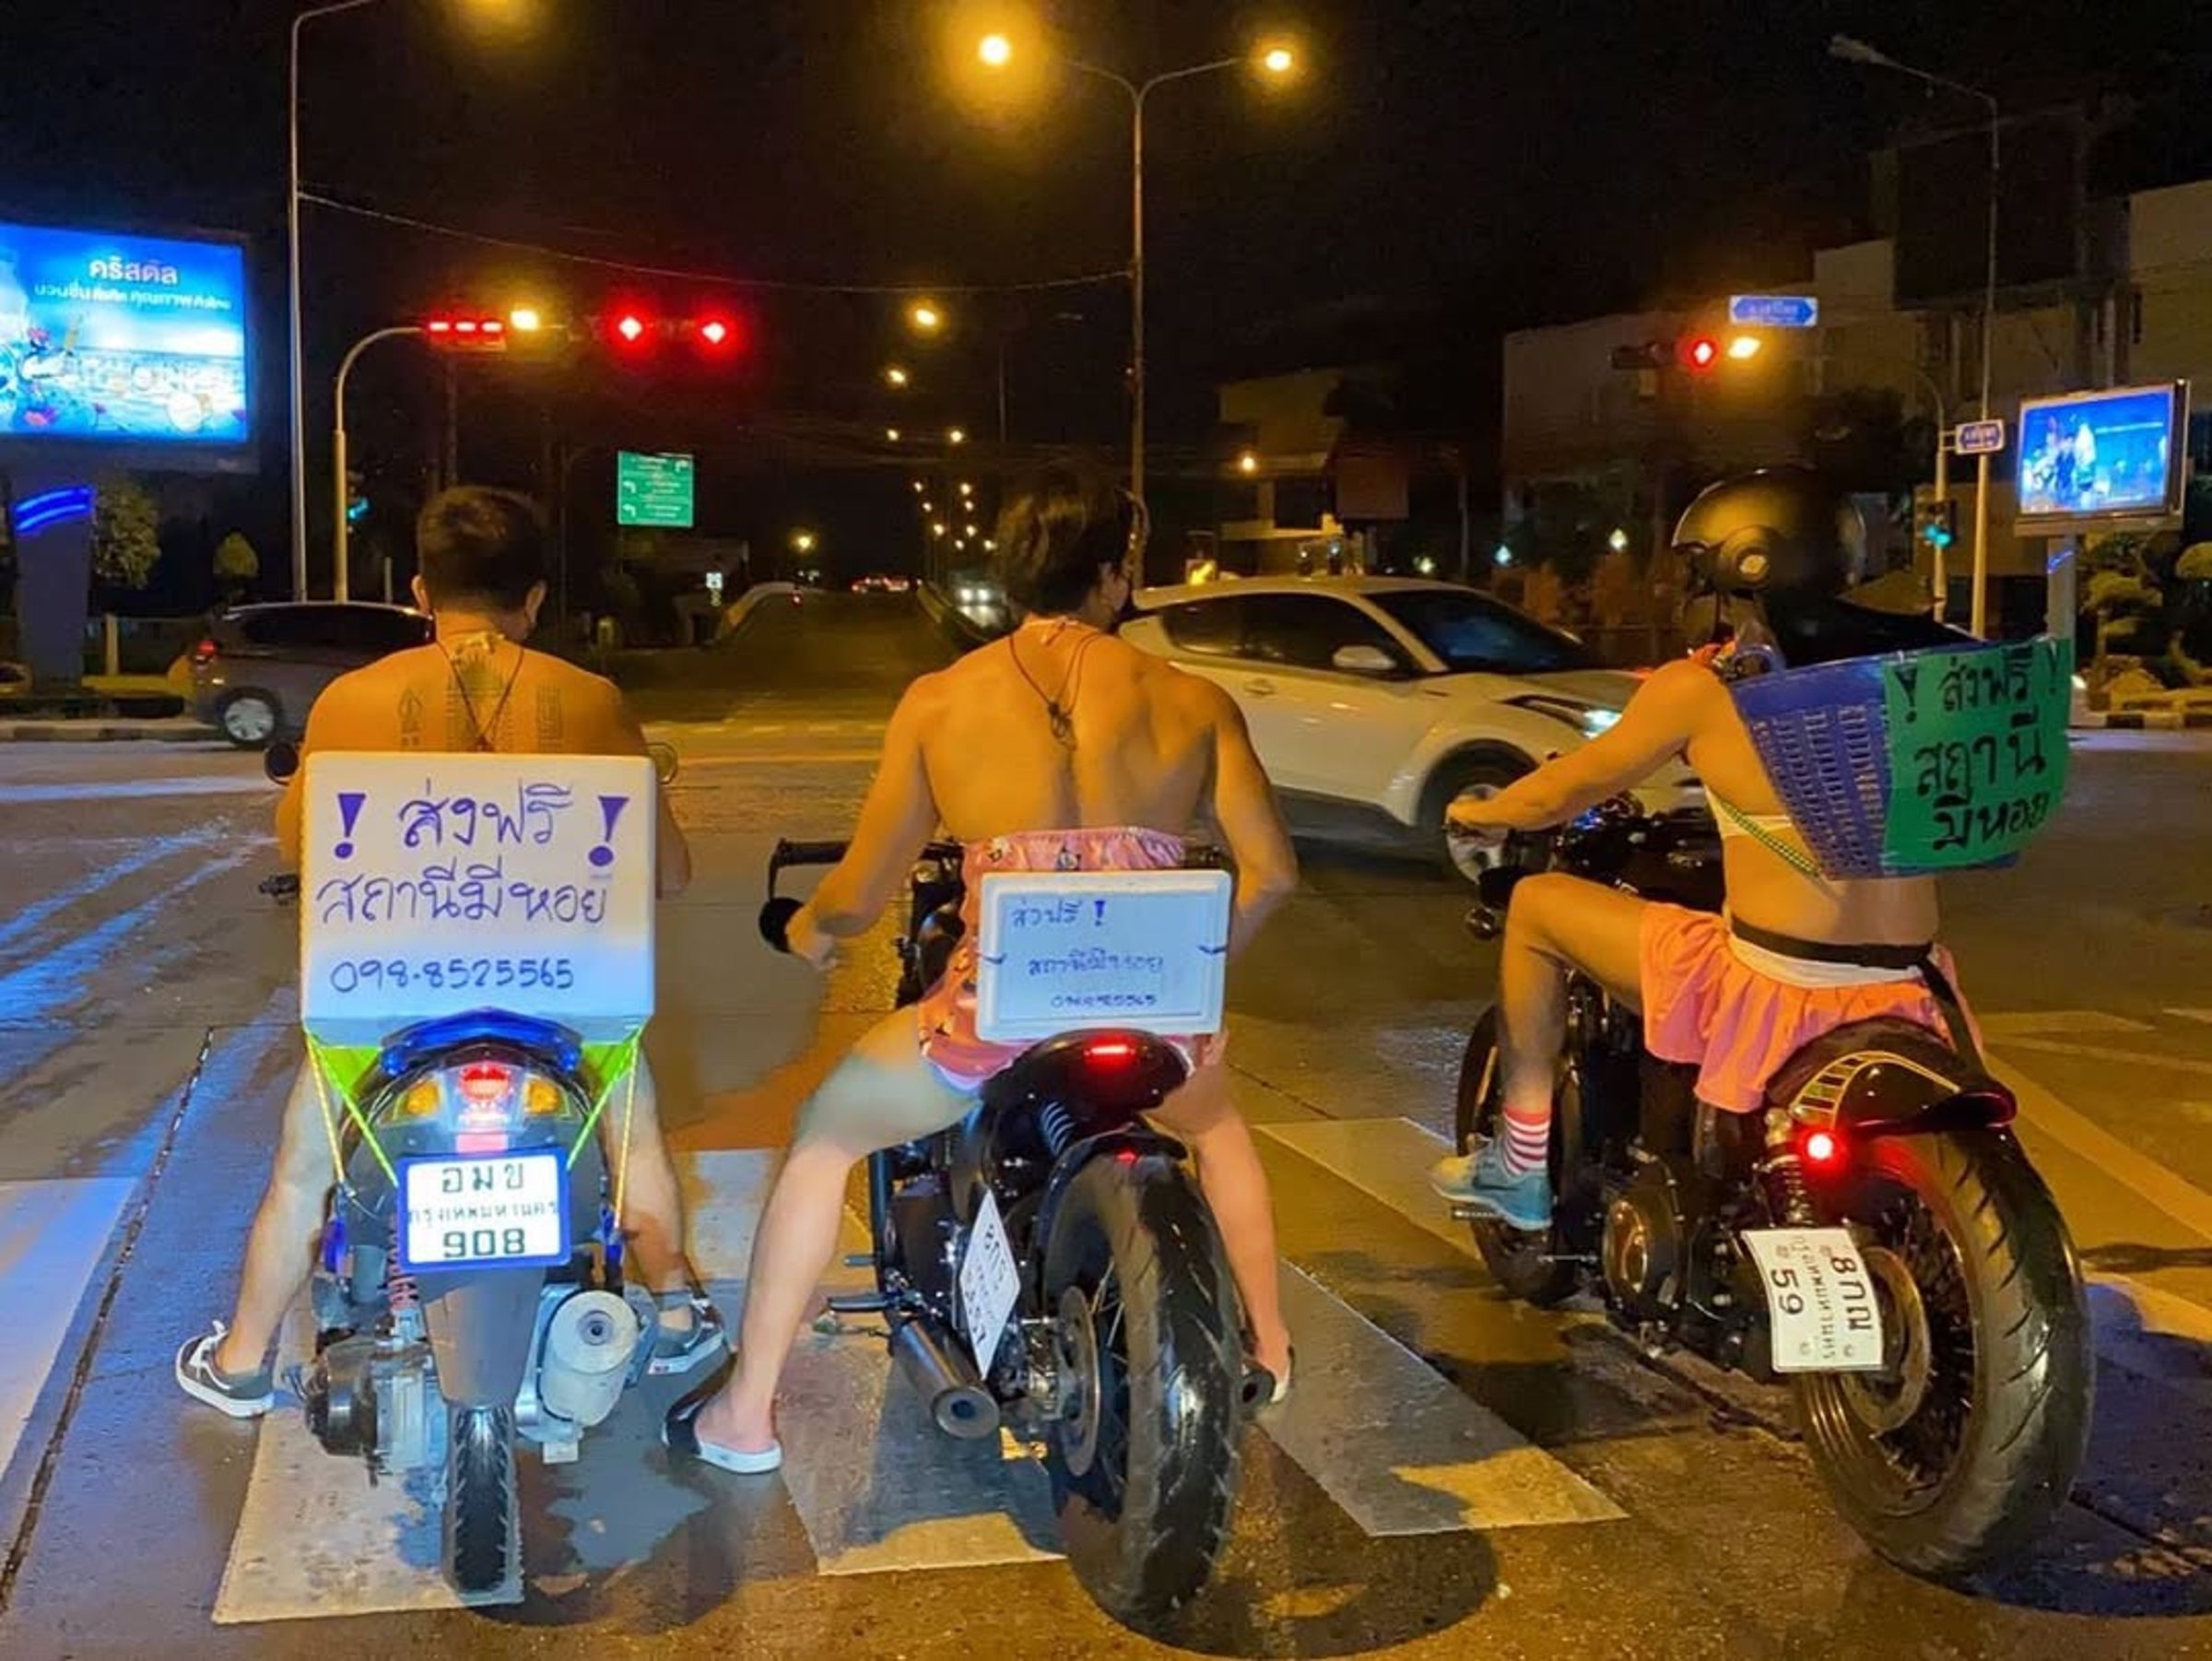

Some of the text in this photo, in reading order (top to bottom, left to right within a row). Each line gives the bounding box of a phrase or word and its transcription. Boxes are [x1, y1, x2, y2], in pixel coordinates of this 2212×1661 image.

[398, 778, 573, 847] ส่งฟรี
[442, 1228, 525, 1258] 908
[1771, 1268, 1805, 1315] 59
